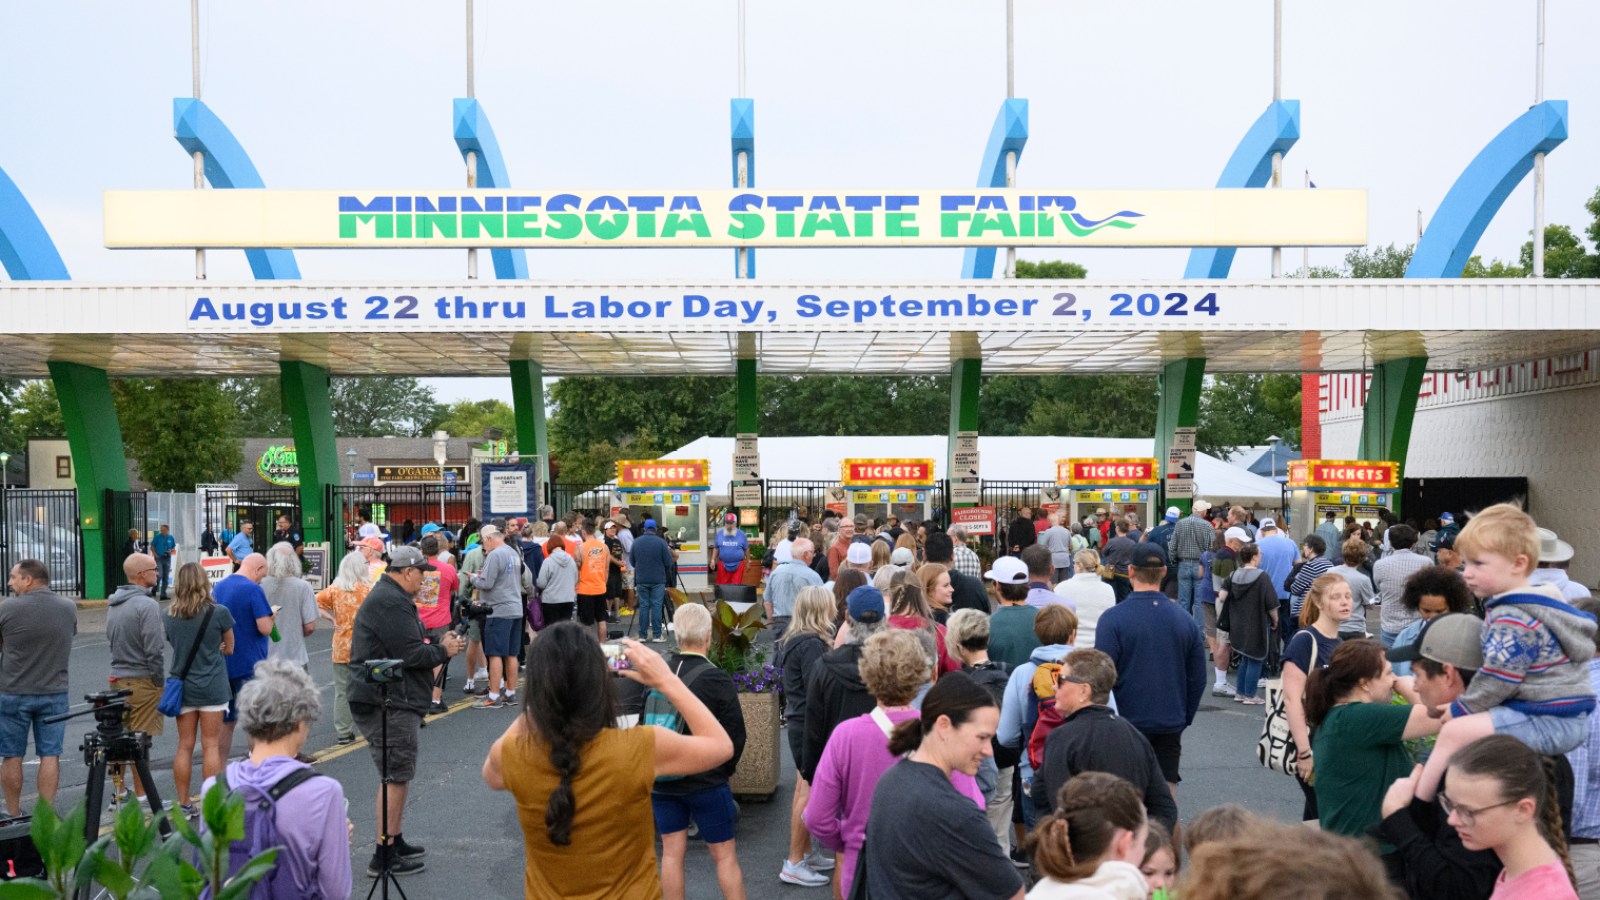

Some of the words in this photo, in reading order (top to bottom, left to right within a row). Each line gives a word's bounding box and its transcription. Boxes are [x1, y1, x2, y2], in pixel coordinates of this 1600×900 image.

[338, 193, 712, 240] MINNESOTA
[727, 193, 920, 240] STATE
[940, 195, 1085, 237] FAIR
[188, 297, 348, 326] August
[364, 295, 419, 320] 22
[434, 295, 526, 319] thru
[544, 295, 673, 319] Labor
[682, 294, 777, 324] Day,
[795, 293, 1038, 323] September
[1052, 292, 1092, 321] 2,
[1109, 292, 1220, 317] 2024
[631, 467, 695, 480] TICKETS
[857, 466, 921, 478] TICKETS
[1081, 466, 1145, 478] TICKETS
[1320, 468, 1384, 481] TICKETS
[207, 569, 225, 578] EXIT
